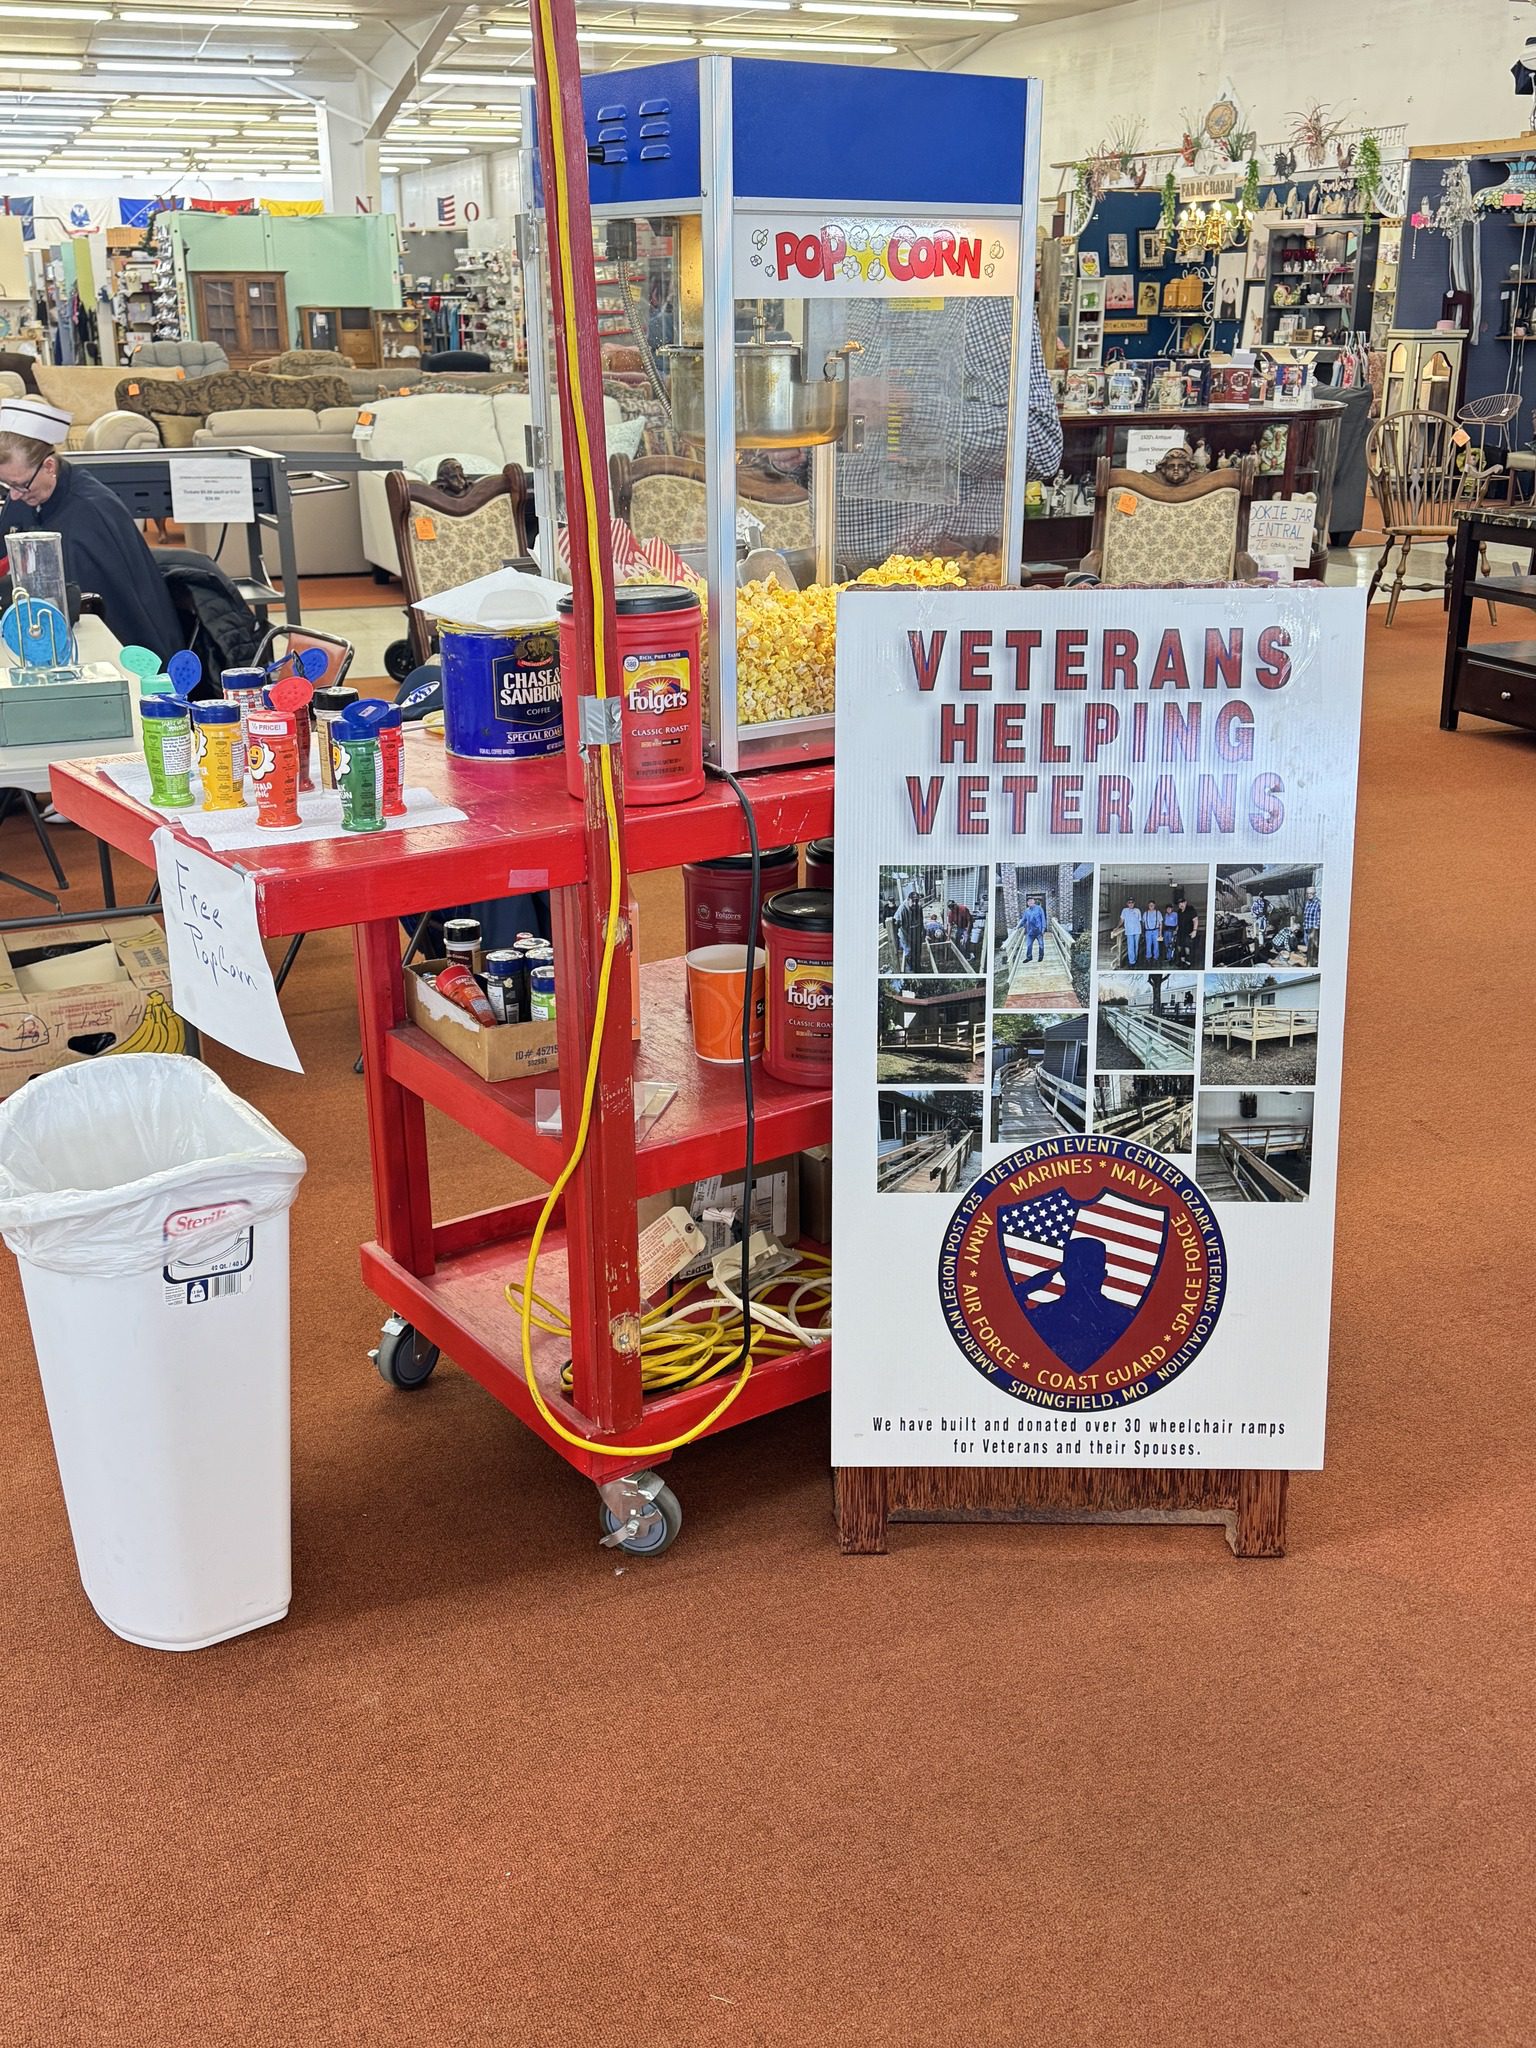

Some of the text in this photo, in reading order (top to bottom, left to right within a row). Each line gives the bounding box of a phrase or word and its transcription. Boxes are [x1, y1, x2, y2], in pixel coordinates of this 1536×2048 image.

[775, 225, 982, 281] POP CORN
[1292, 507, 1312, 522] JAR
[907, 626, 1293, 691] VETERANS
[527, 706, 551, 716] COFFEE
[628, 688, 688, 715] Folgers
[507, 731, 541, 743] SPECIAL
[631, 724, 687, 737] CLASSIC ROAST
[939, 700, 1255, 764] HELPING
[906, 772, 1286, 835] VETERANS
[175, 859, 223, 929] Free
[715, 911, 742, 922] Folgers
[787, 984, 834, 1010] Folger
[788, 1018, 815, 1027] CLASSIC
[515, 1049, 533, 1061] ID#
[984, 1138, 1184, 1188] VETERAN EVENT CENTER
[1009, 1159, 1093, 1196] MARINES
[1111, 1163, 1163, 1197] NAVY
[964, 1212, 994, 1265] ARMY
[943, 1192, 999, 1375] AMERICAN LEGION POST 125
[1156, 1189, 1222, 1381] OZARK VETERANS COALITION
[1170, 1212, 1202, 1335] SPACE FORCE
[962, 1283, 1020, 1369] AIR FORCE
[1037, 1345, 1167, 1391] COAST GUARD
[1008, 1380, 1149, 1410] SPRINGFIELD, MO
[873, 1417, 1286, 1438] We have built and donated over 30 wheelchair ramps
[954, 1438, 1201, 1458] for Veterans and their Spouses.
